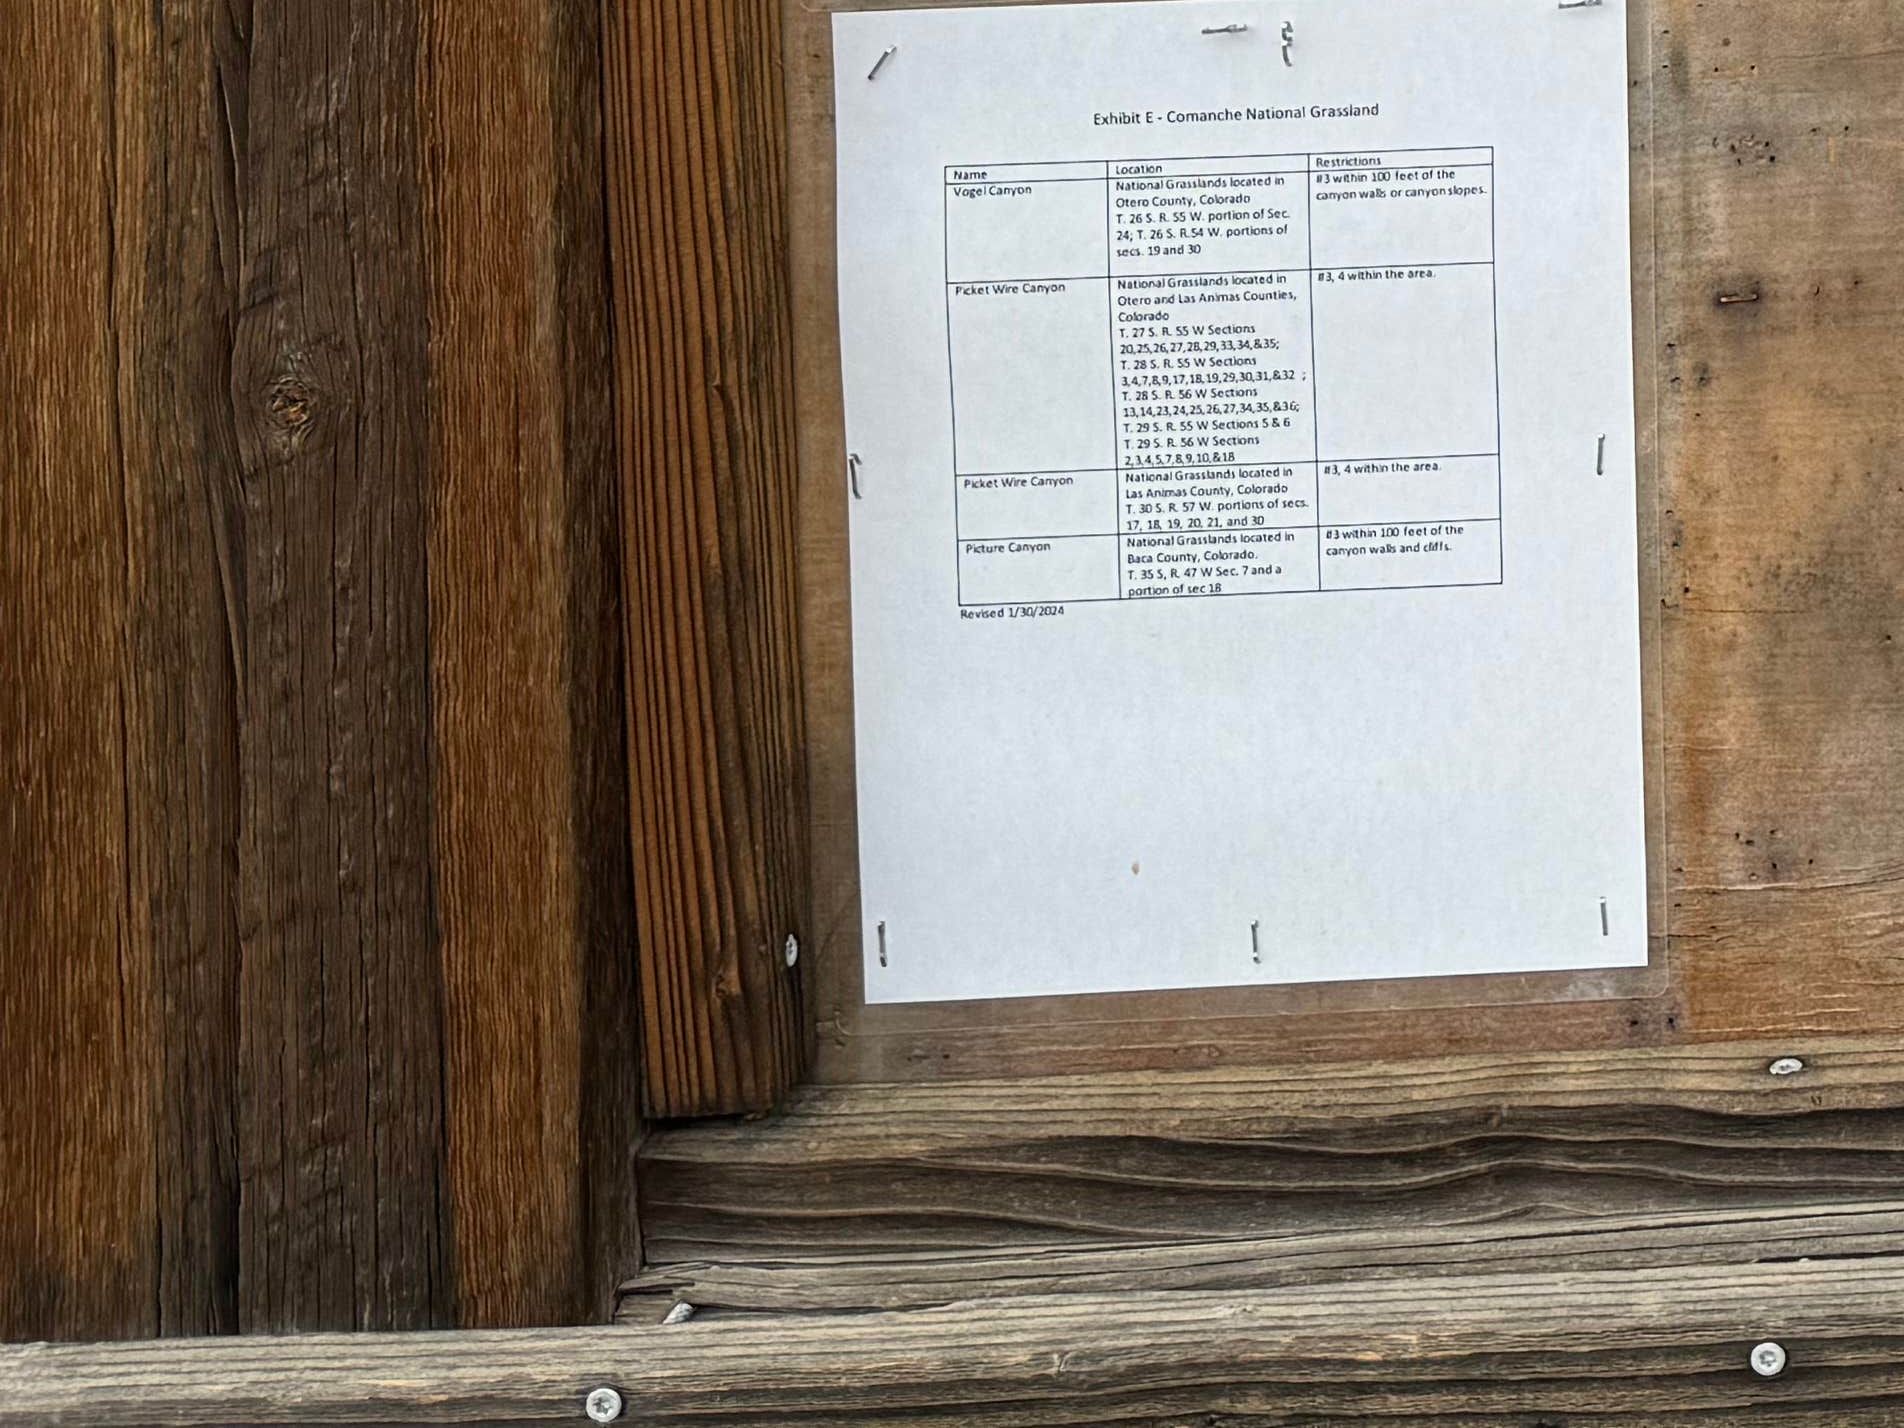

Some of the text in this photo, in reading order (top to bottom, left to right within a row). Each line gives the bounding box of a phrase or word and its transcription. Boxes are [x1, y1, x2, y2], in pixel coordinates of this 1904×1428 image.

[1094, 111, 1141, 125] Exhibit
[1146, 111, 1154, 124] E
[1167, 107, 1243, 123] Comanche
[1246, 106, 1306, 120] National
[1310, 102, 1380, 117] Grassland
[1316, 156, 1382, 168] Restrictions
[954, 170, 988, 180] Name
[1116, 164, 1163, 175] Location
[953, 183, 1032, 199] Vogel Canyon
[955, 280, 1067, 297] Picket Wire Canyon
[964, 475, 1074, 489] Picket Wire Canyon
[966, 541, 1052, 554] Picture Canyon
[961, 604, 1065, 619] Revised 1/30/2024
